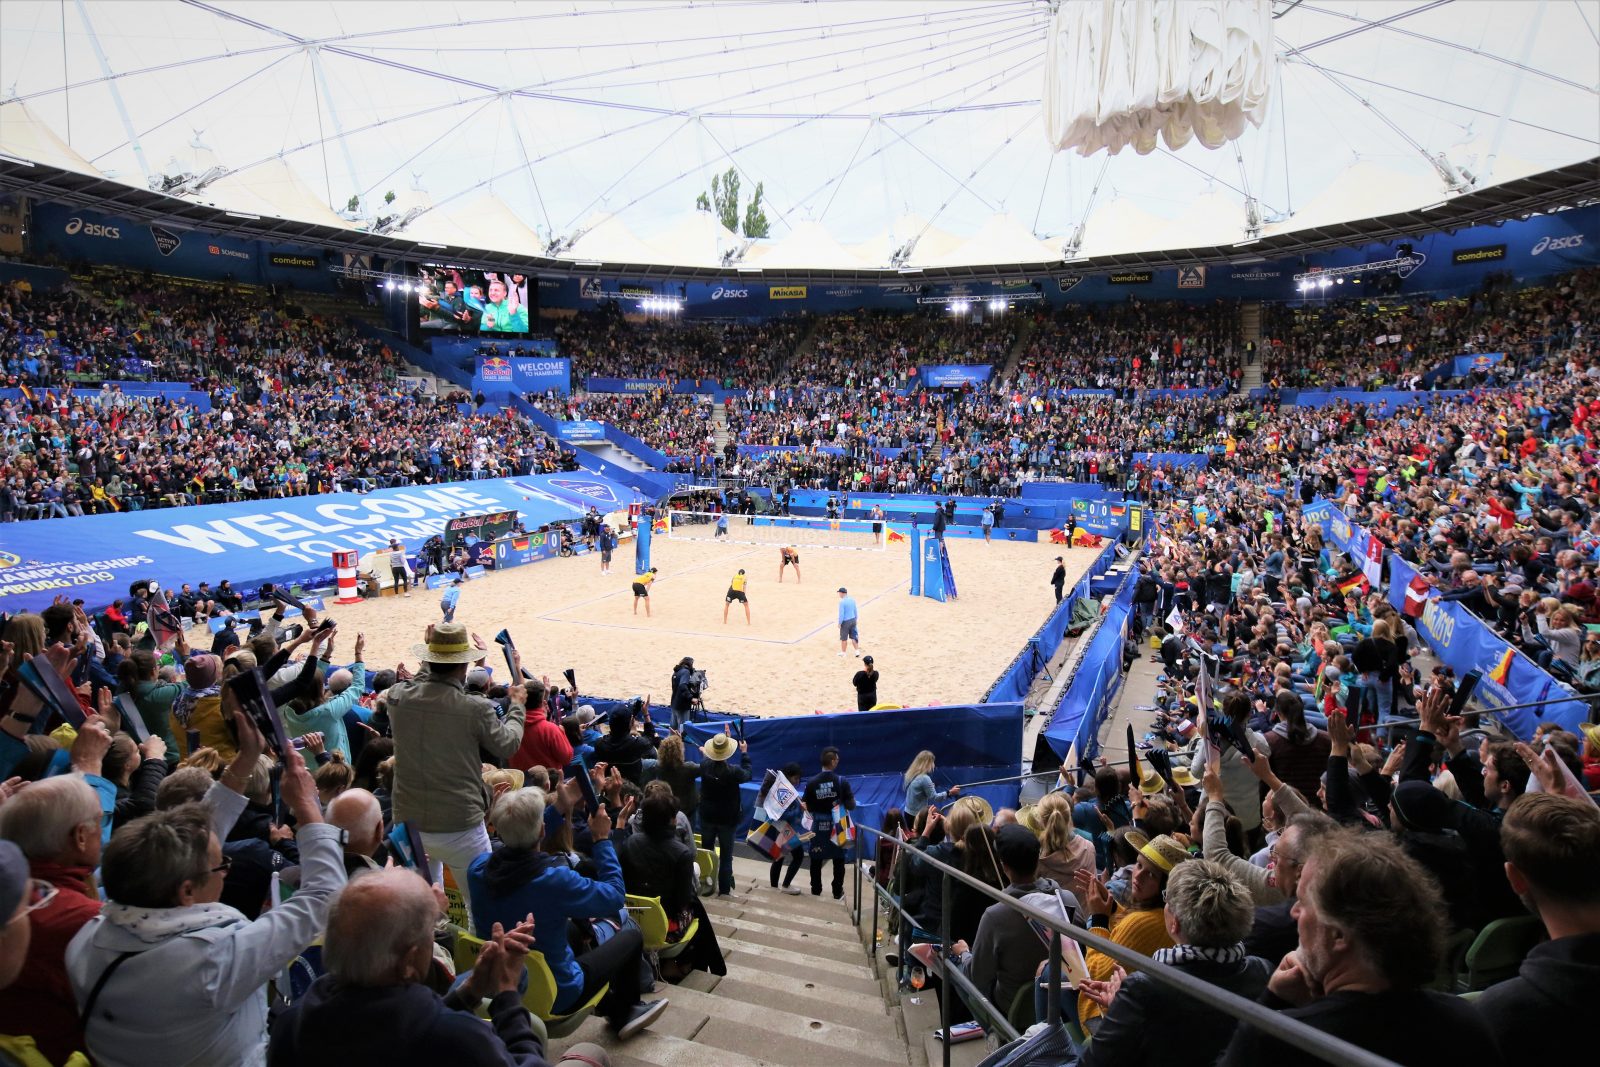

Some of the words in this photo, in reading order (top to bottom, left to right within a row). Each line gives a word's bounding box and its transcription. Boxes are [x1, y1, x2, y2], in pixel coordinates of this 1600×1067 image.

[83, 223, 120, 239] asics
[157, 237, 177, 246] ACTIVE
[1548, 234, 1584, 250] asics
[221, 249, 250, 260] SCHENKER
[273, 257, 316, 266] comdirect
[1456, 249, 1502, 261] comdirect
[723, 289, 748, 298] asics
[517, 362, 564, 372] WELCOME
[534, 369, 563, 377] HAMBURG
[1089, 503, 1095, 515] 0
[1101, 505, 1107, 516] 0
[133, 485, 500, 554] WELCOME
[551, 533, 557, 548] 0
[264, 540, 342, 563] TO
[499, 543, 506, 559] 0
[0, 555, 154, 584] AMPIONSHIPS
[0, 578, 73, 598] MBURG
[68, 571, 115, 586] 2019
